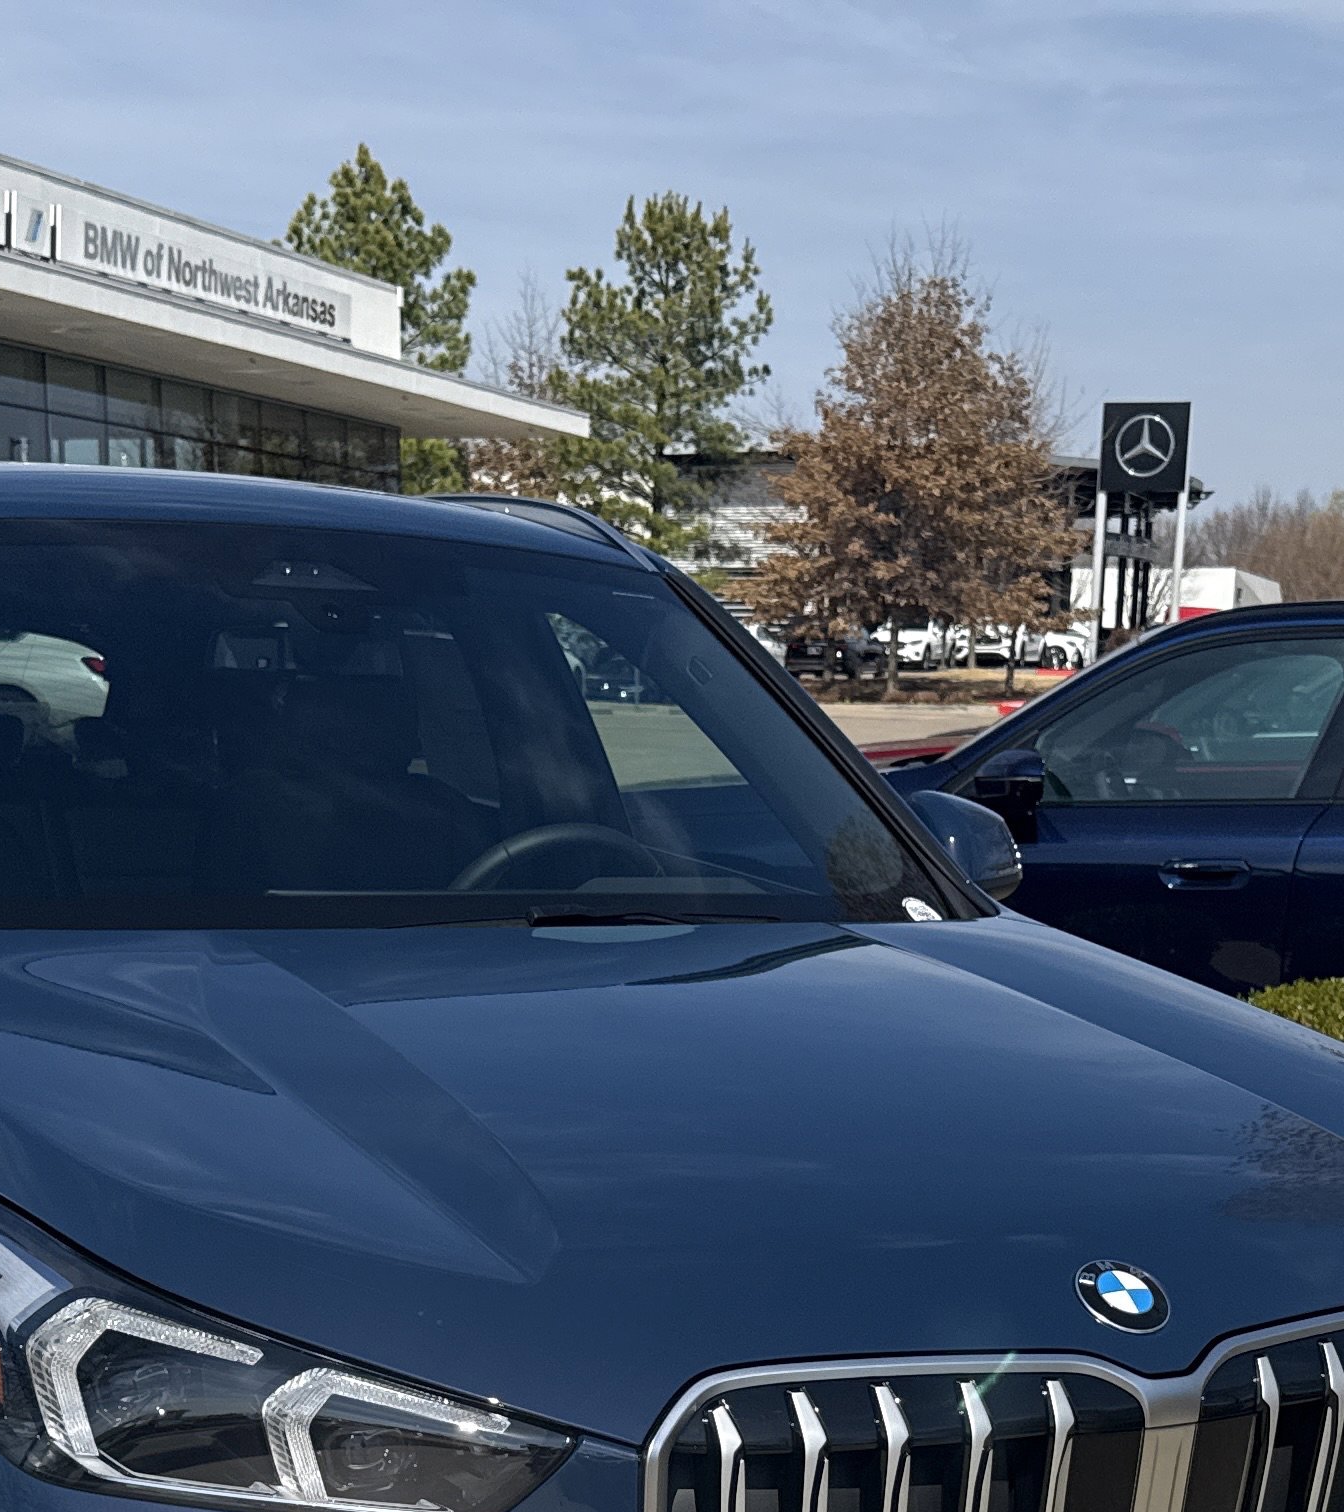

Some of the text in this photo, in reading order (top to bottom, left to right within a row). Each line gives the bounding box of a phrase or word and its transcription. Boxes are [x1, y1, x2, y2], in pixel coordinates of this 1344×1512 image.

[83, 221, 336, 328] BMW of Northwest Arkansas
